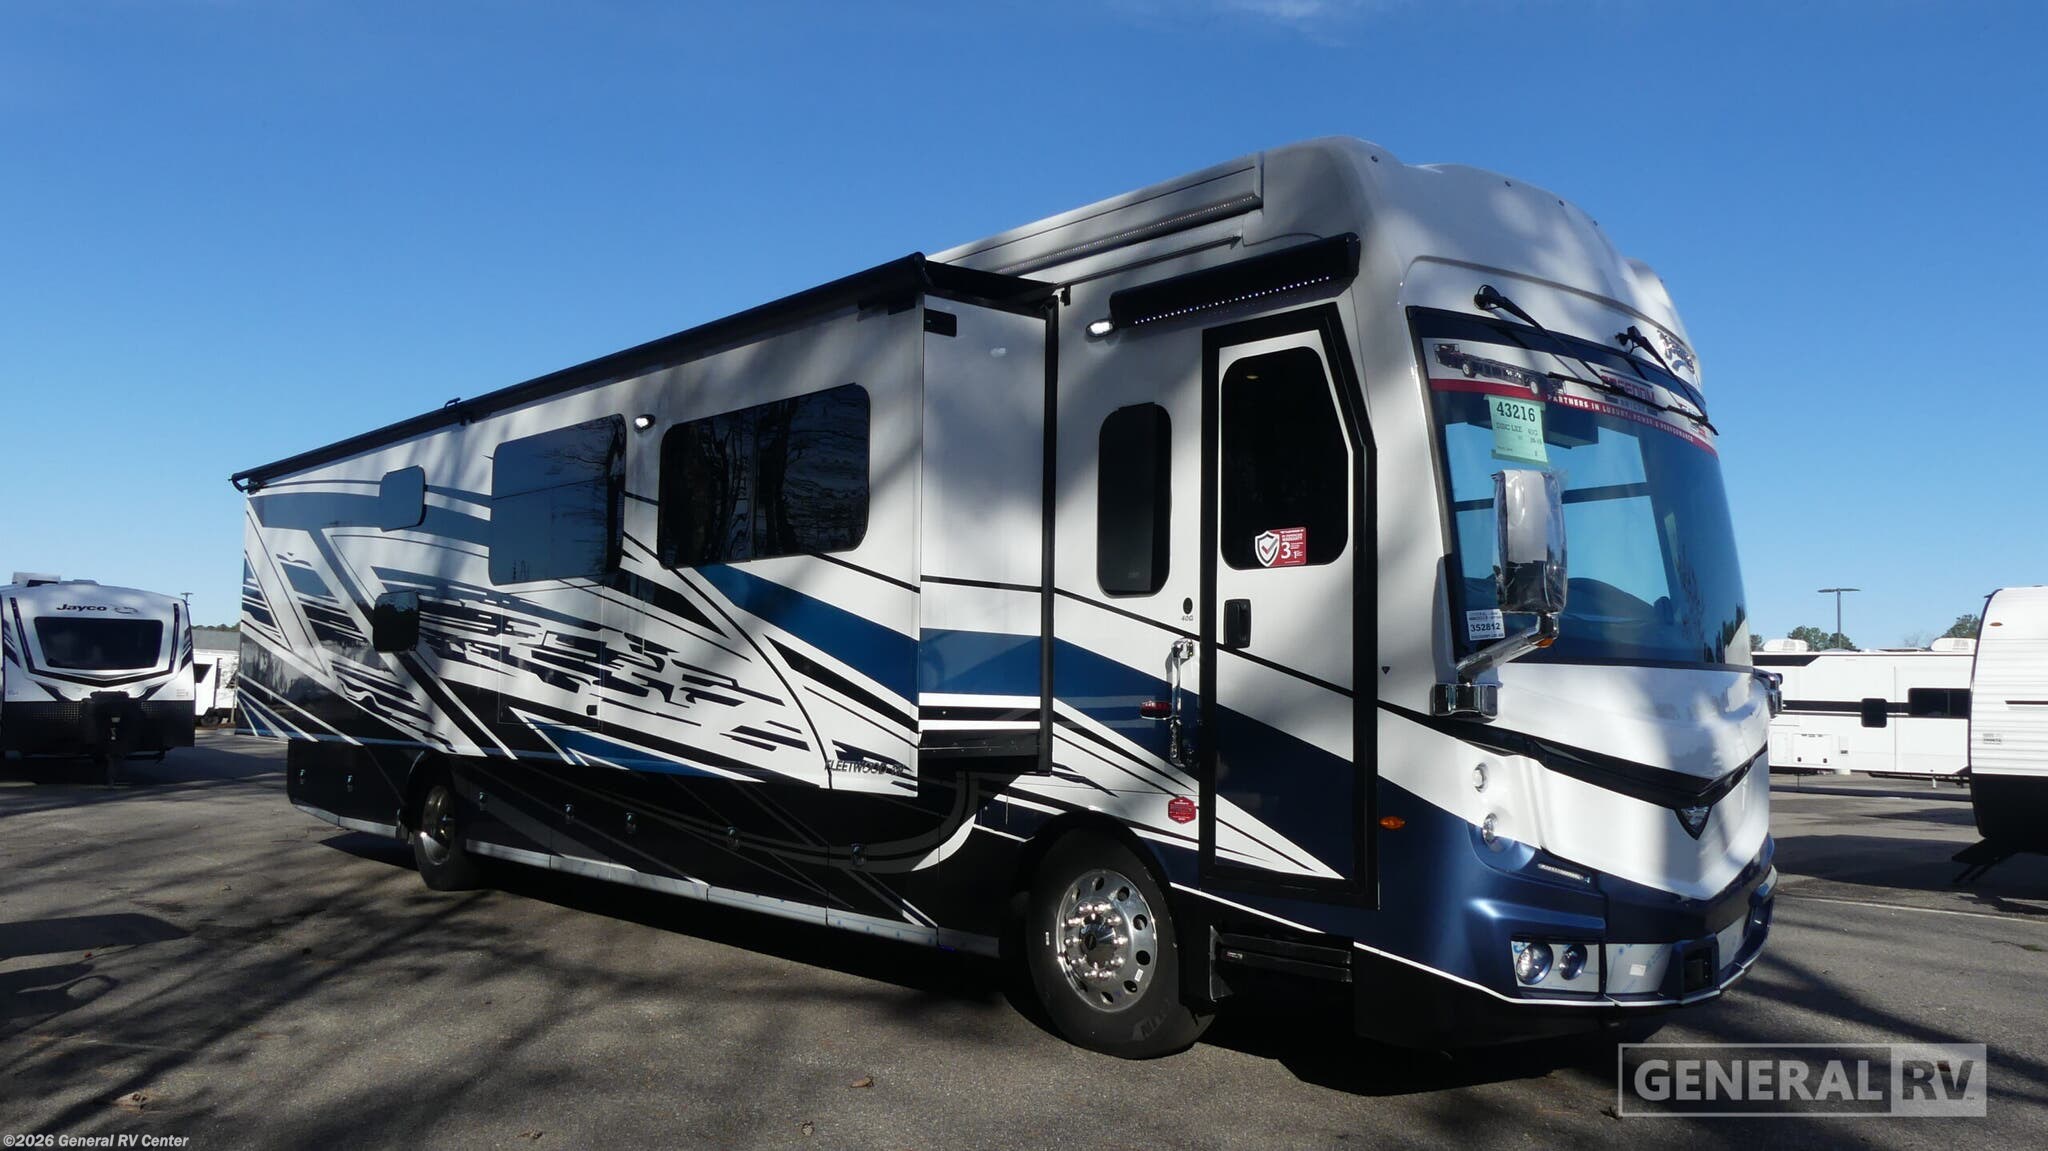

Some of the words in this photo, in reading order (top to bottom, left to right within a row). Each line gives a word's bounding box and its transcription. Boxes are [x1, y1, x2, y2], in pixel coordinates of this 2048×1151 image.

[1496, 401, 1536, 422] 43216
[1592, 402, 1600, 411] IN
[56, 603, 107, 612] Jayco
[825, 760, 887, 775] FLEETWOOD
